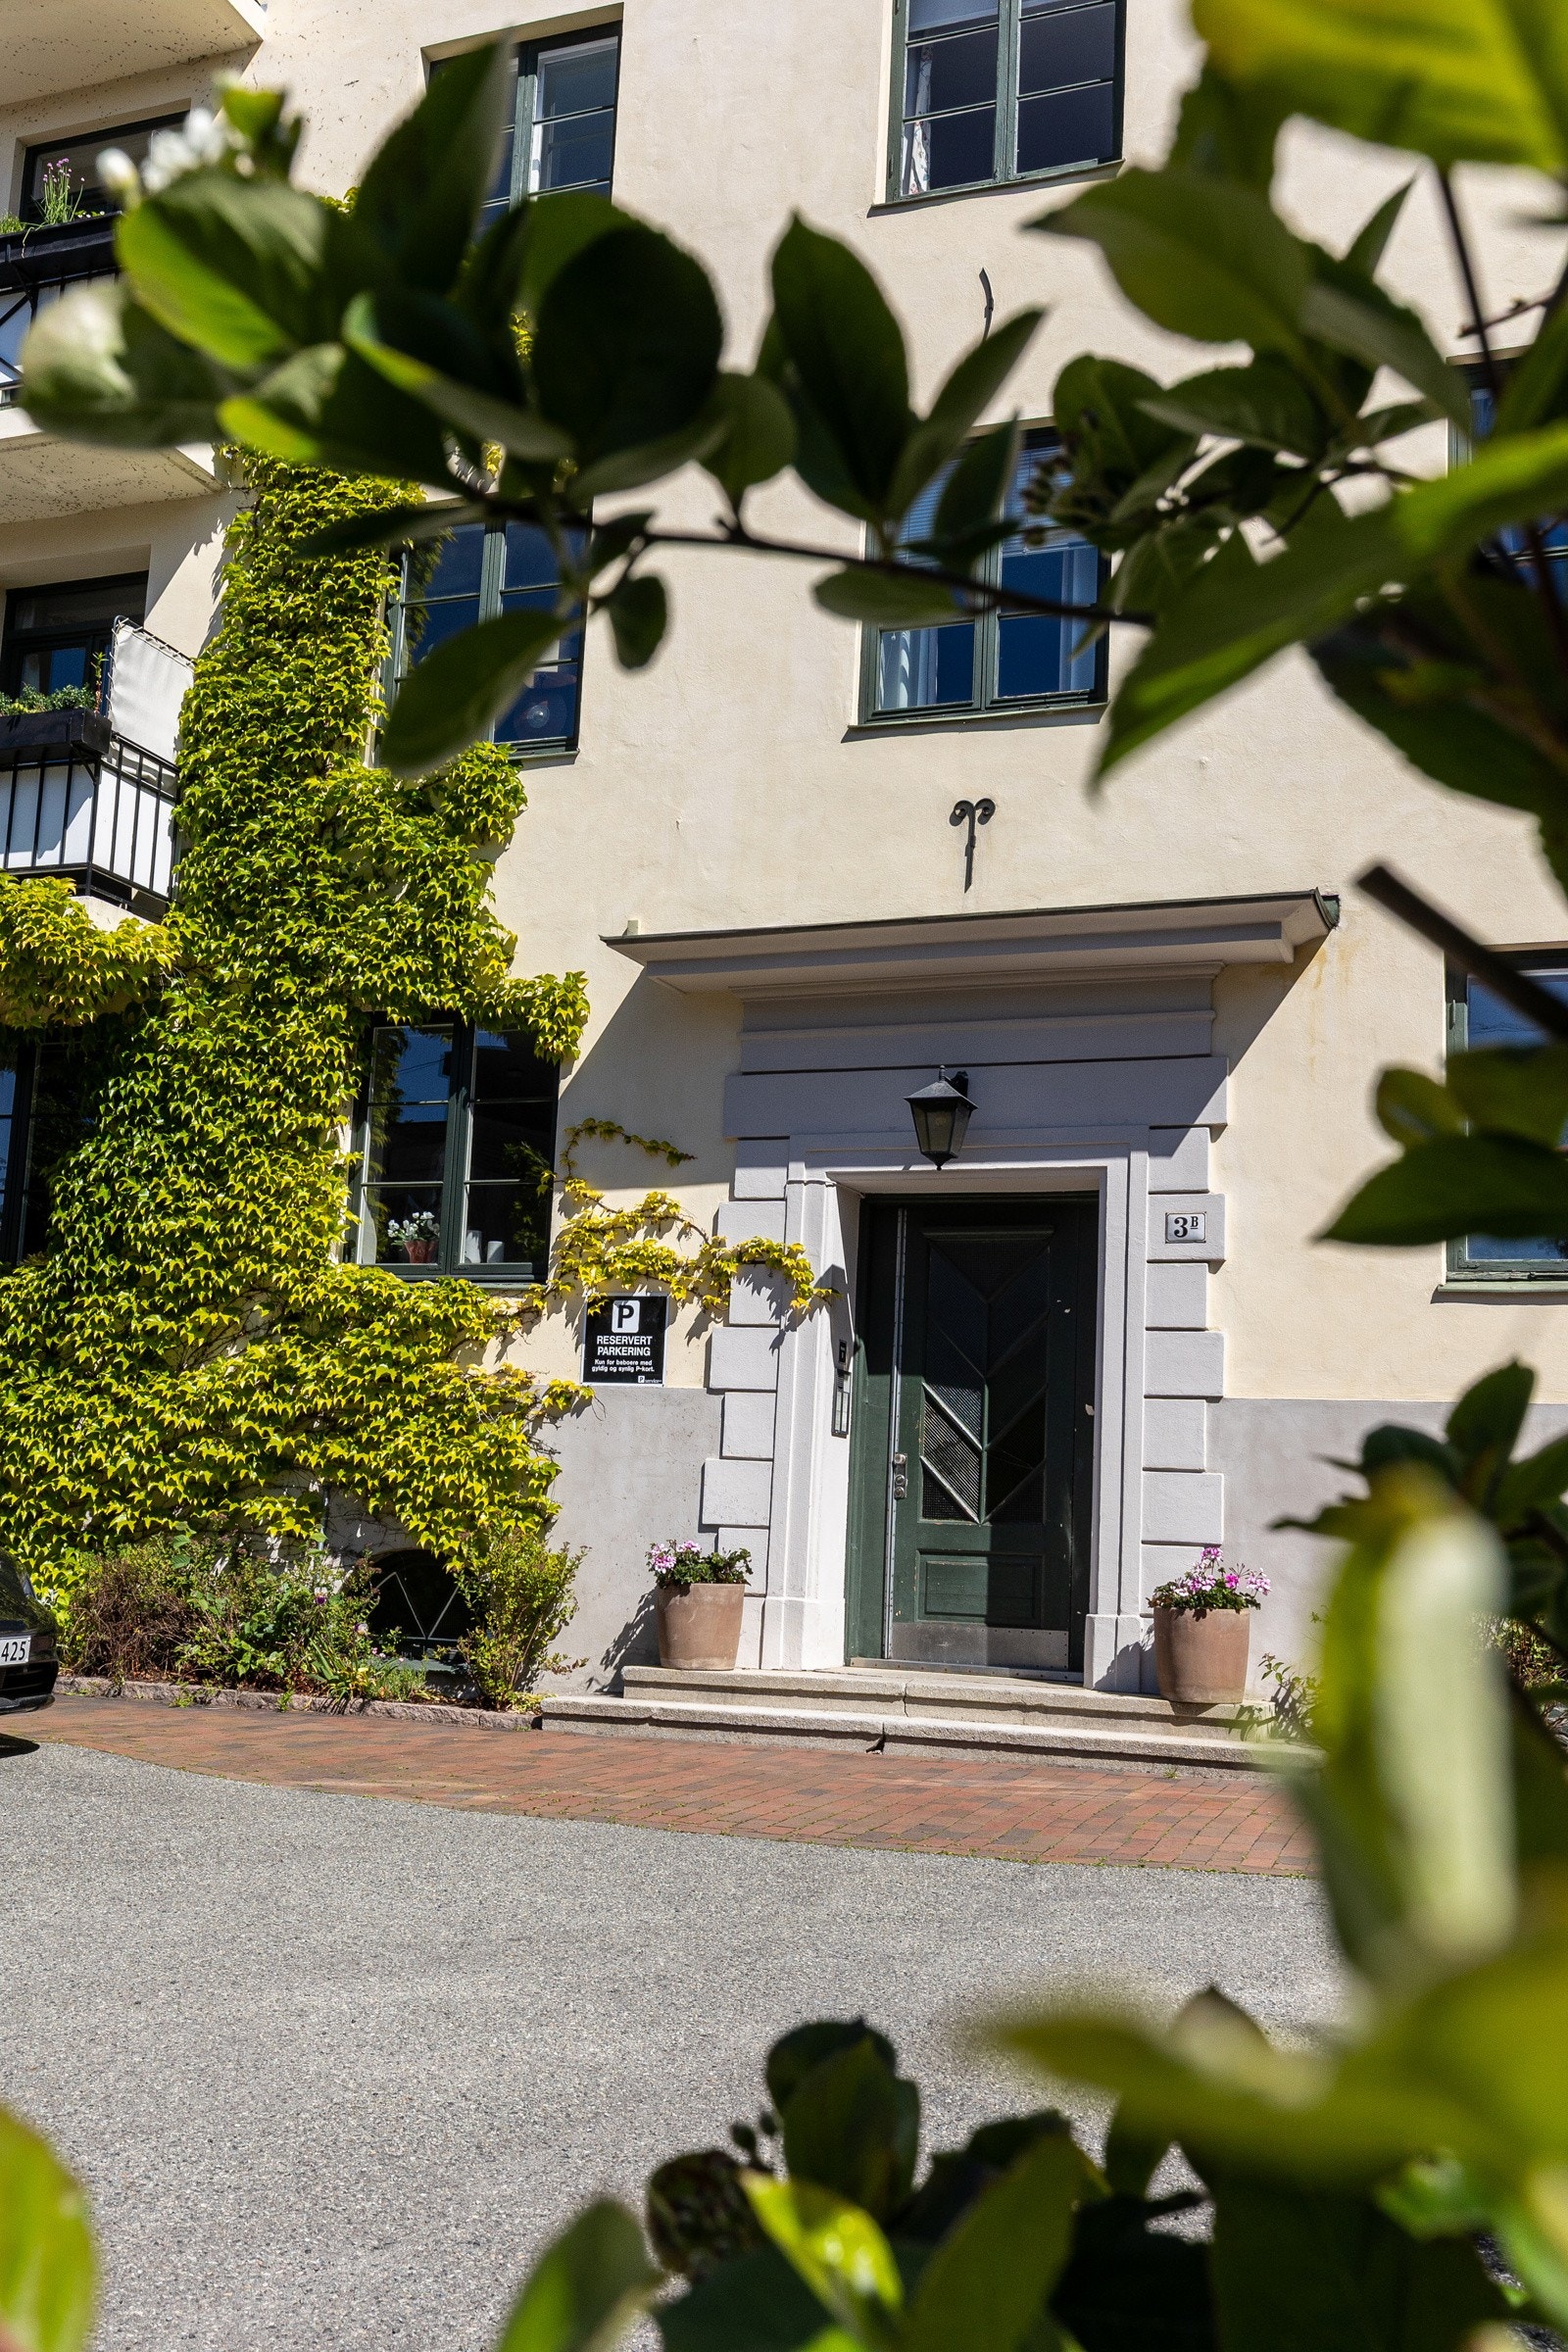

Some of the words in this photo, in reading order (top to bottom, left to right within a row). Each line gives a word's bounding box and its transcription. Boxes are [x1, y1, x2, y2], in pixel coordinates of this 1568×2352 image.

[617, 1304, 635, 1329] P
[596, 1335, 653, 1346] RESERVERT
[597, 1347, 651, 1356] PARKERING
[1, 1641, 26, 1662] 425
